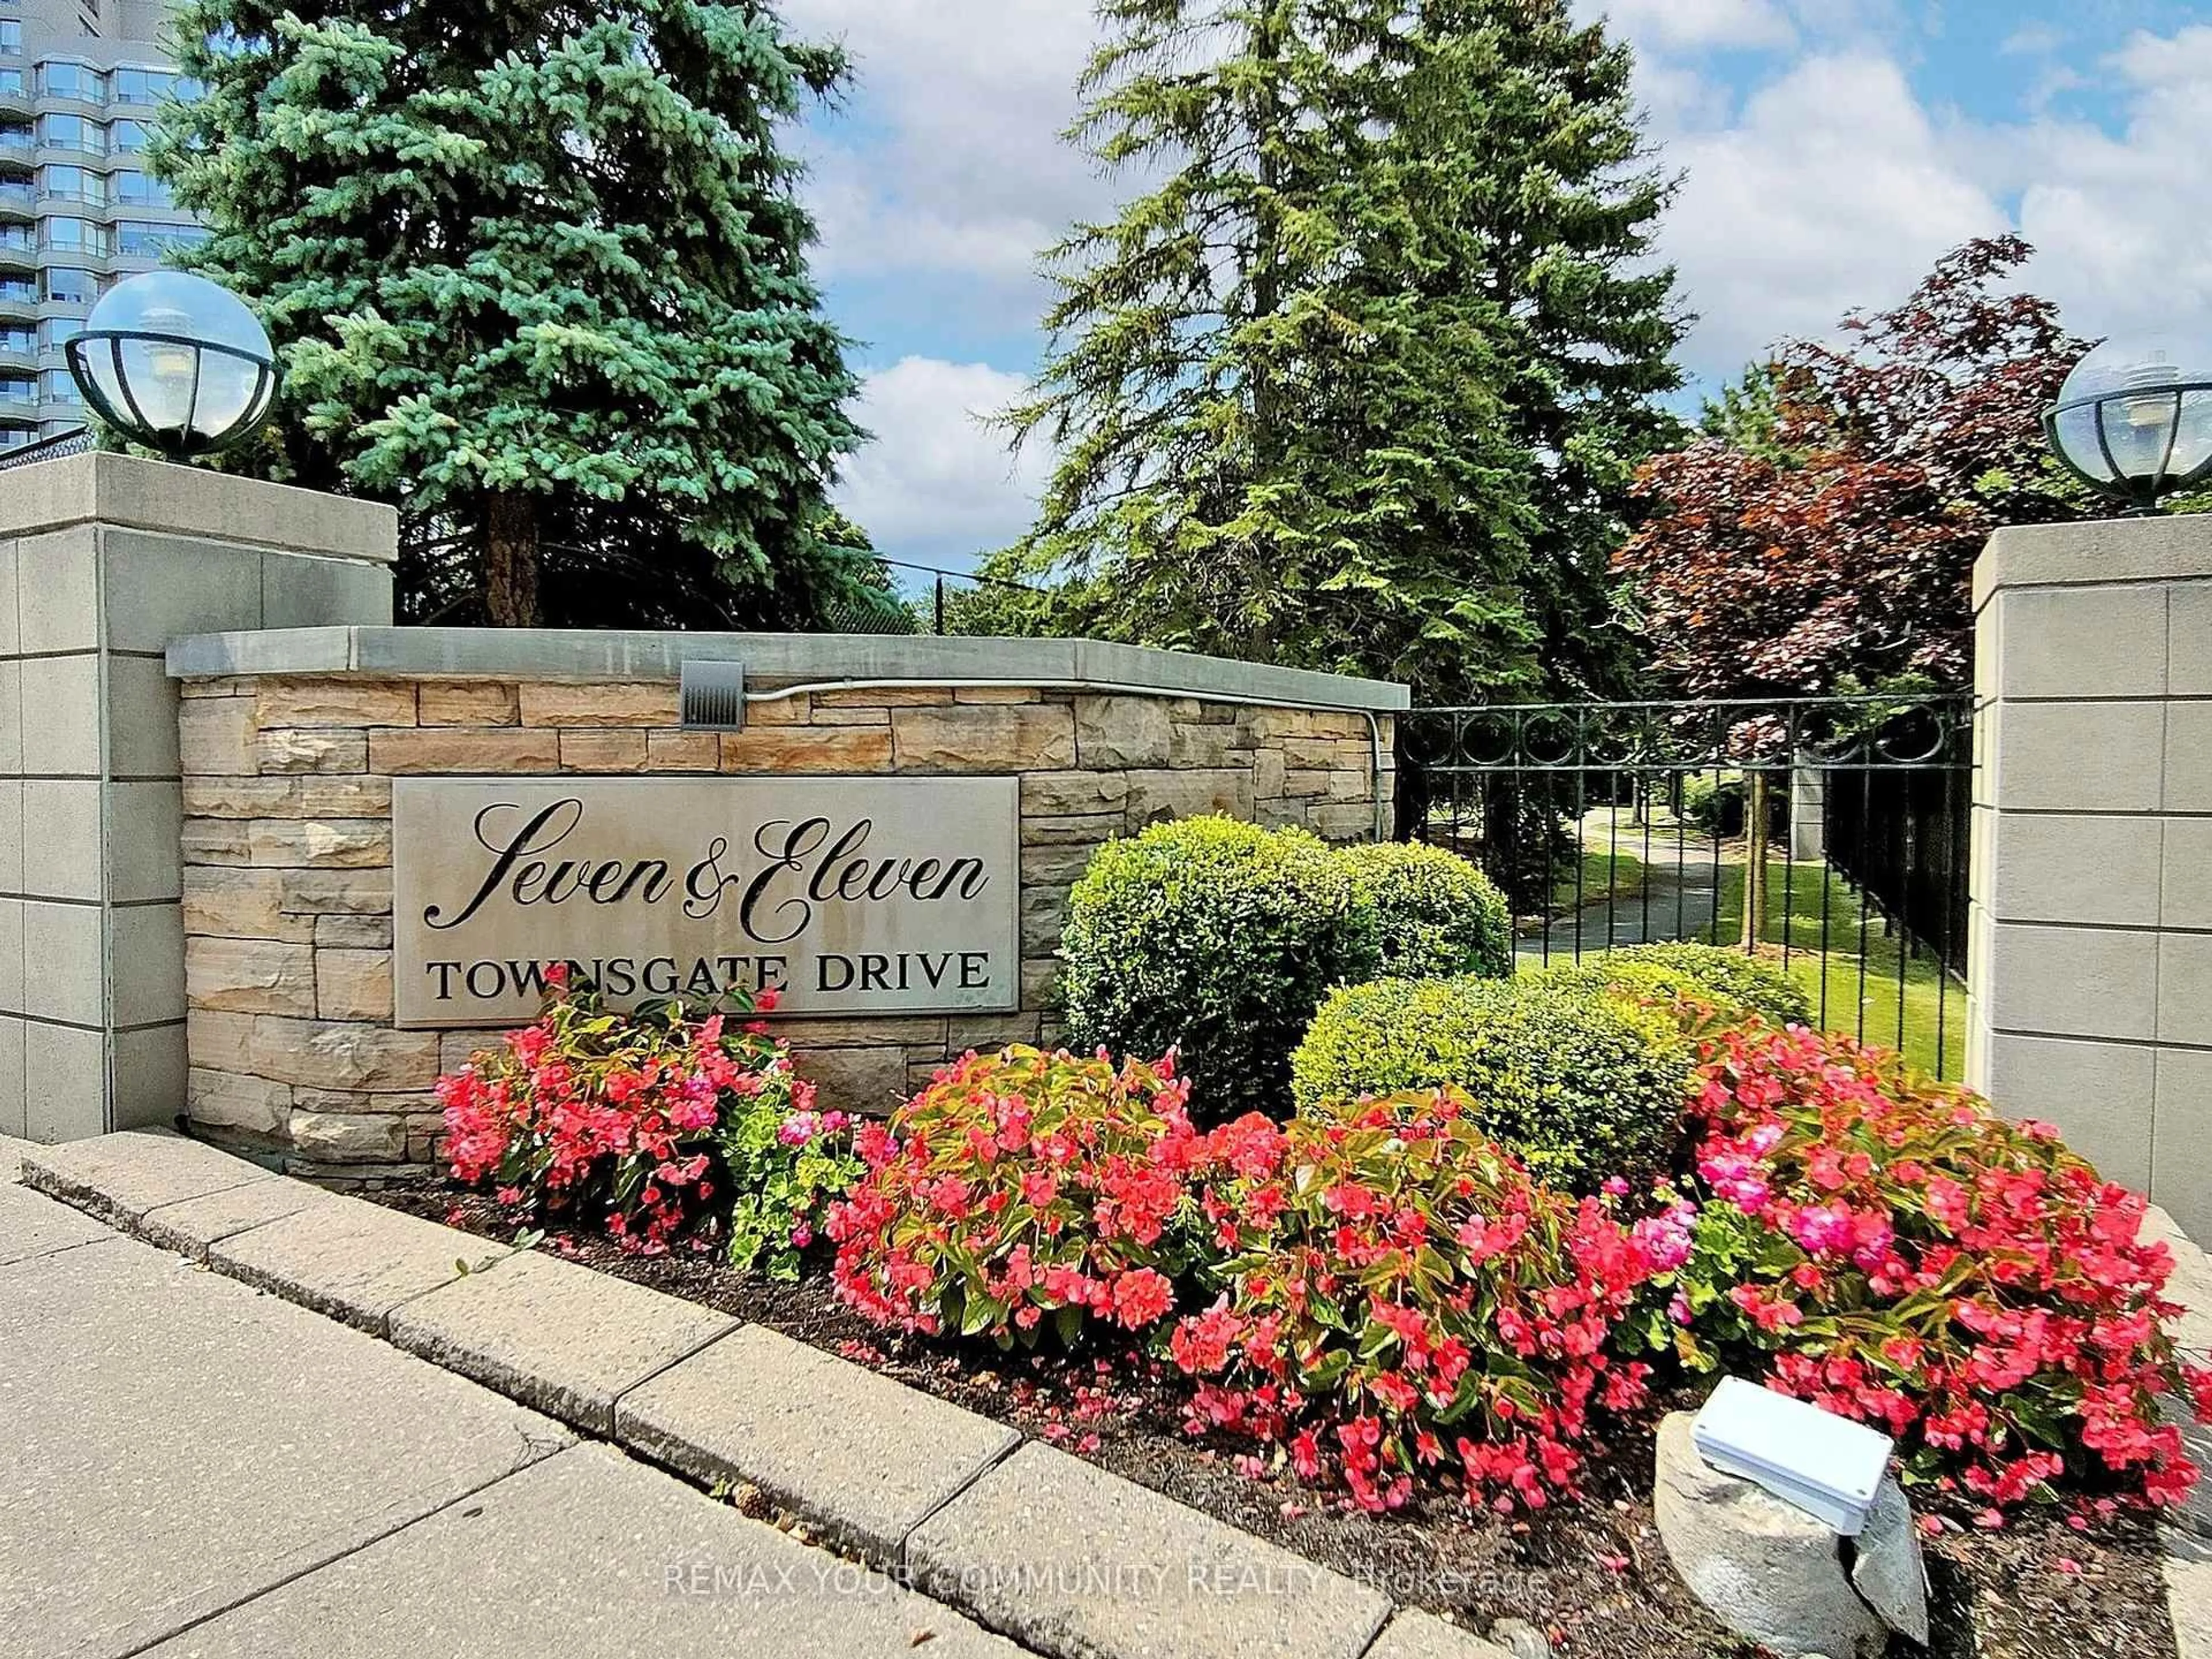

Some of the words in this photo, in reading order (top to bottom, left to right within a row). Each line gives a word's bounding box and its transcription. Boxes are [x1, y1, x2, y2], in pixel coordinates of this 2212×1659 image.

[424, 799, 674, 929] Seven
[682, 837, 738, 919] &
[740, 817, 990, 943] Eleven
[816, 952, 990, 991] DRIVE
